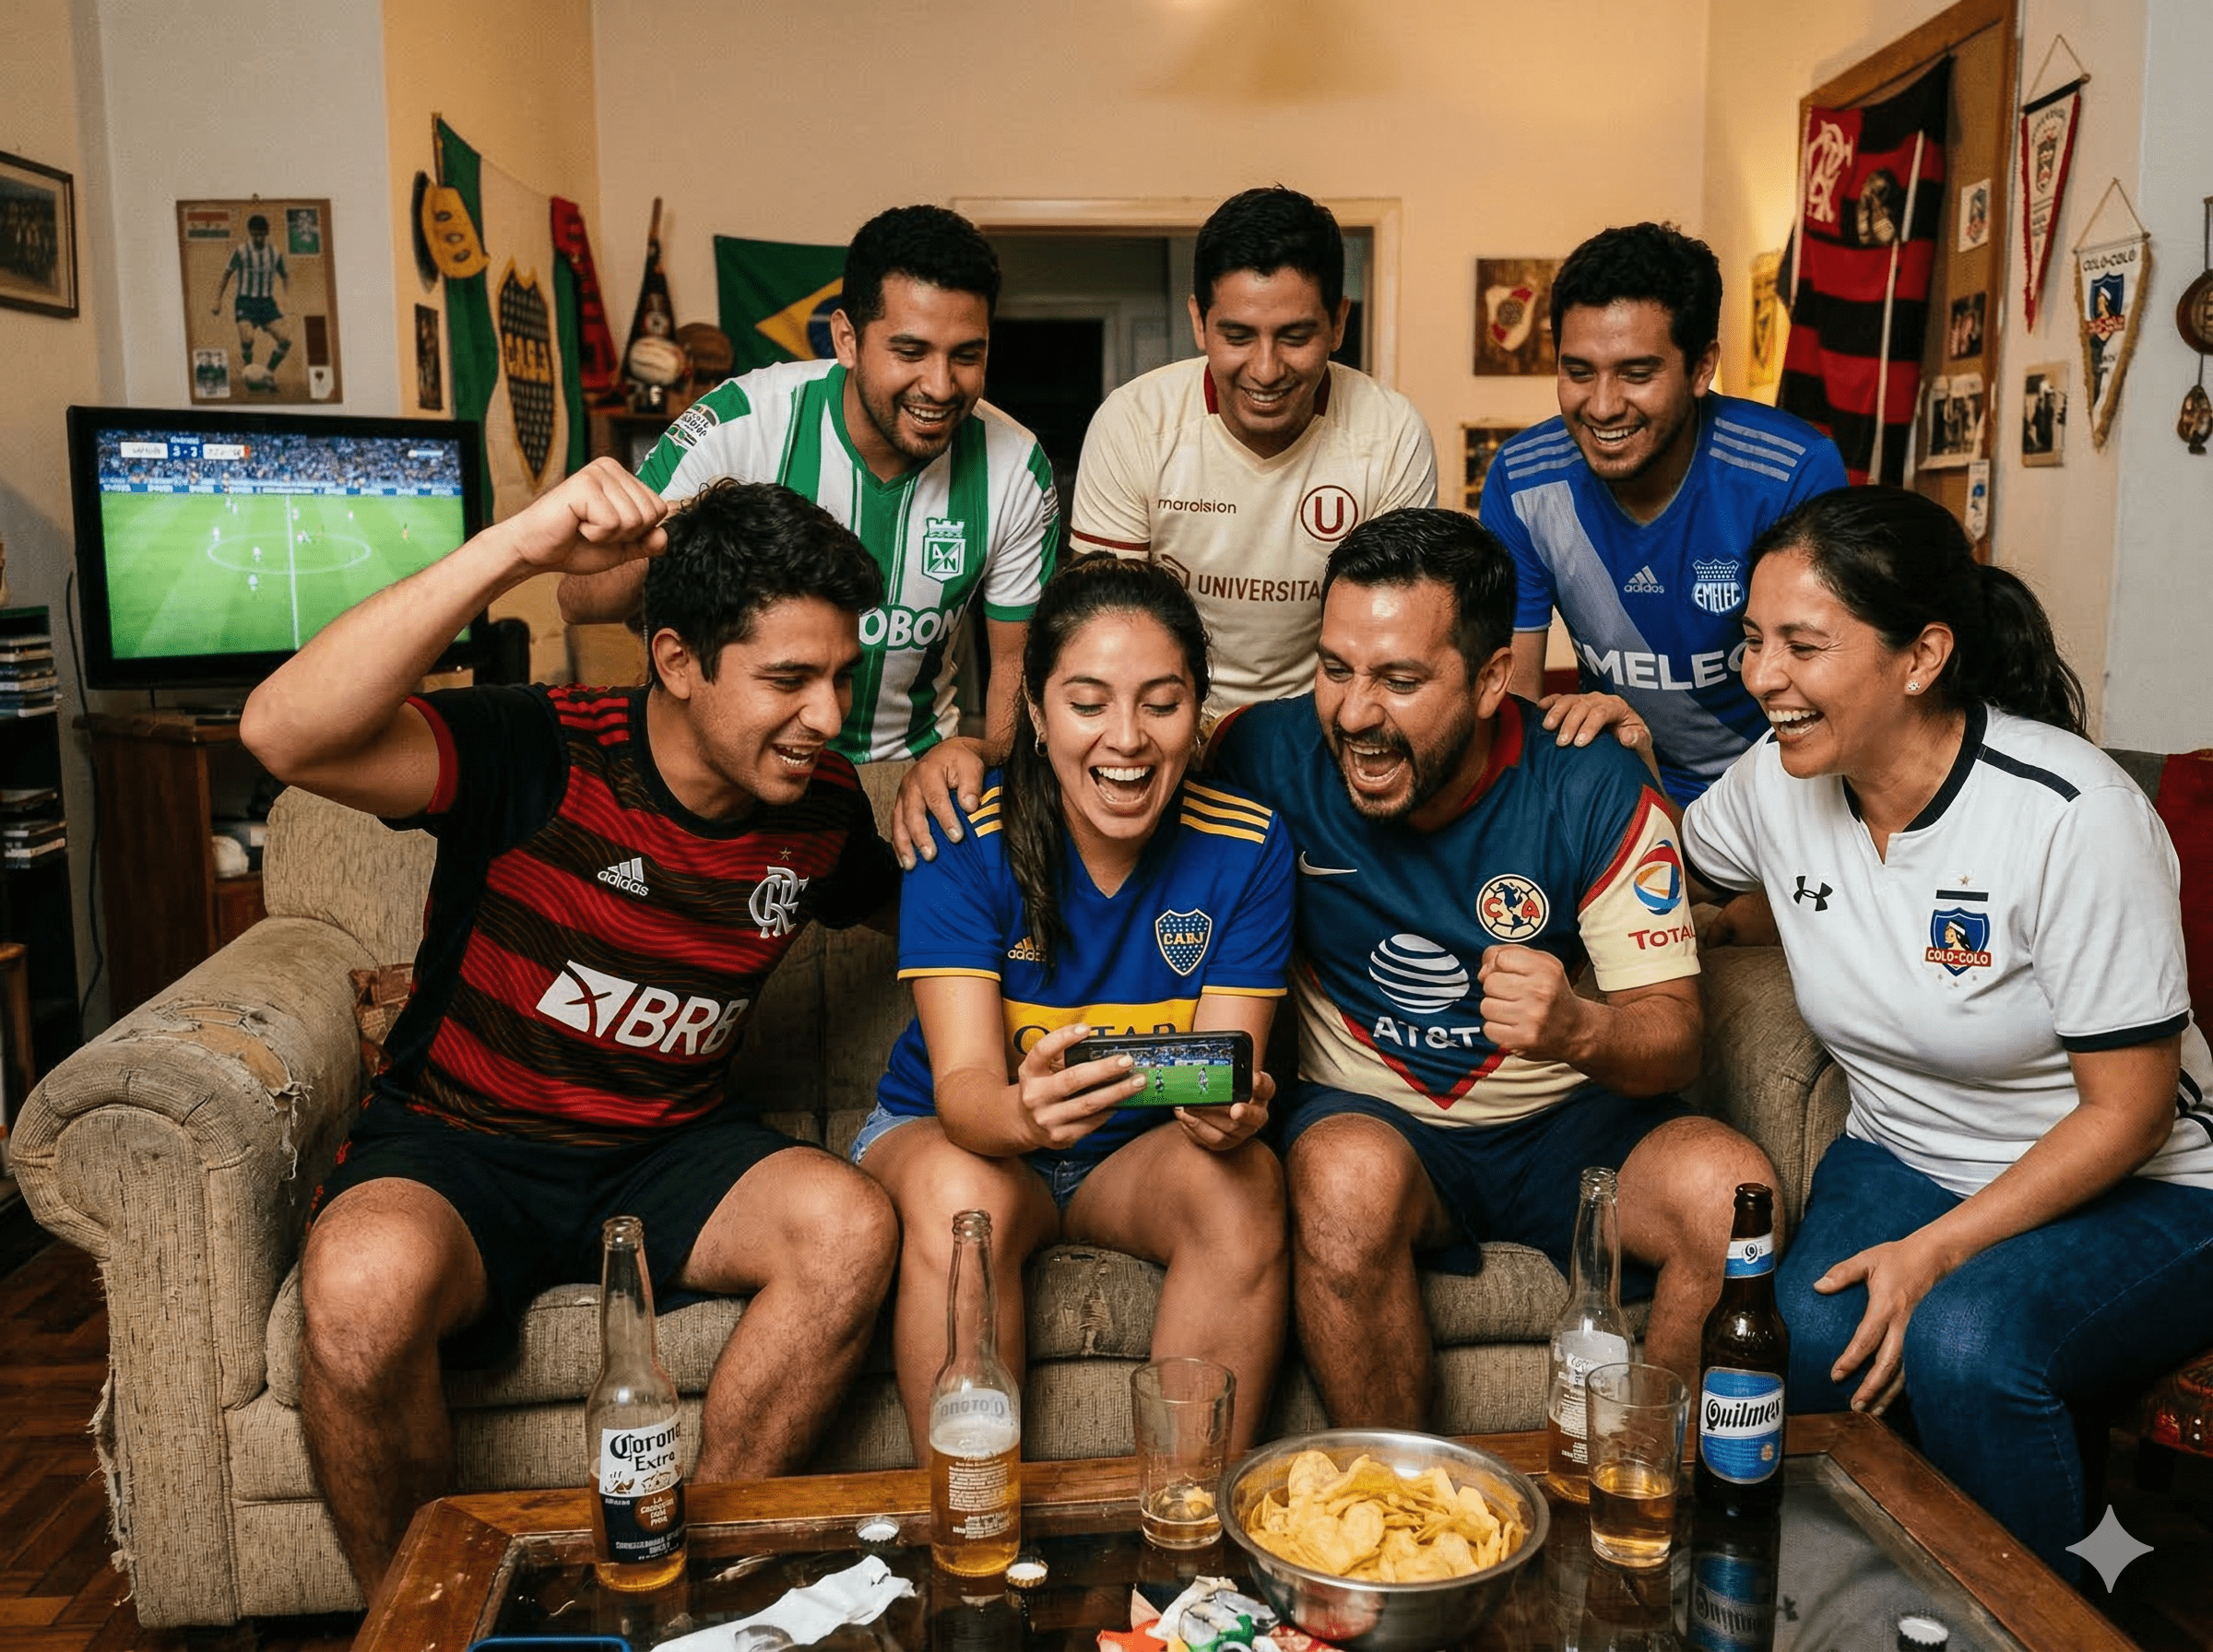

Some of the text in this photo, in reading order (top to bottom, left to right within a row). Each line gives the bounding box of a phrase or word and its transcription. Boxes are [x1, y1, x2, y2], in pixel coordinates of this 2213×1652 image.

[1315, 496, 1344, 535] U
[1694, 582, 1741, 614] EMELEC
[598, 870, 649, 896] adidas
[1927, 950, 1988, 965] COLO-COLO
[615, 986, 750, 1056] BRB
[1374, 1016, 1481, 1049] AT&T
[609, 1421, 681, 1461] Corona
[634, 1451, 675, 1472] Extra
